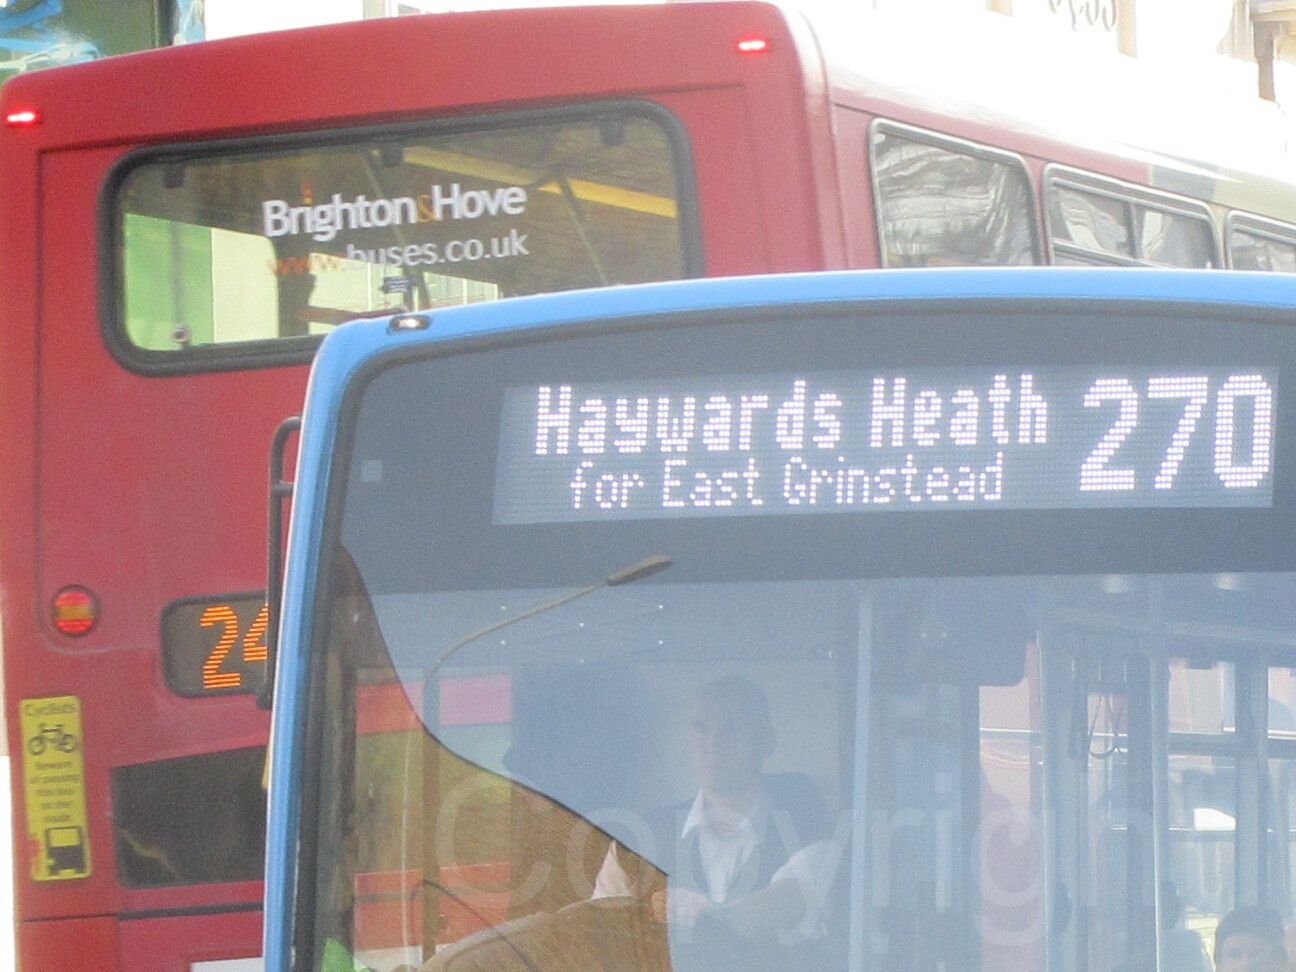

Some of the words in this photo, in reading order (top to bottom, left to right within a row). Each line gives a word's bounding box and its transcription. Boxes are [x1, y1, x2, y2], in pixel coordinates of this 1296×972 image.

[268, 229, 530, 276] www.buses.co.uk
[536, 380, 842, 455] Haywards
[871, 374, 1047, 449] Heath
[1080, 374, 1273, 492] 270
[570, 460, 644, 509] for
[662, 459, 764, 507] East
[783, 452, 1004, 505] Grinstead
